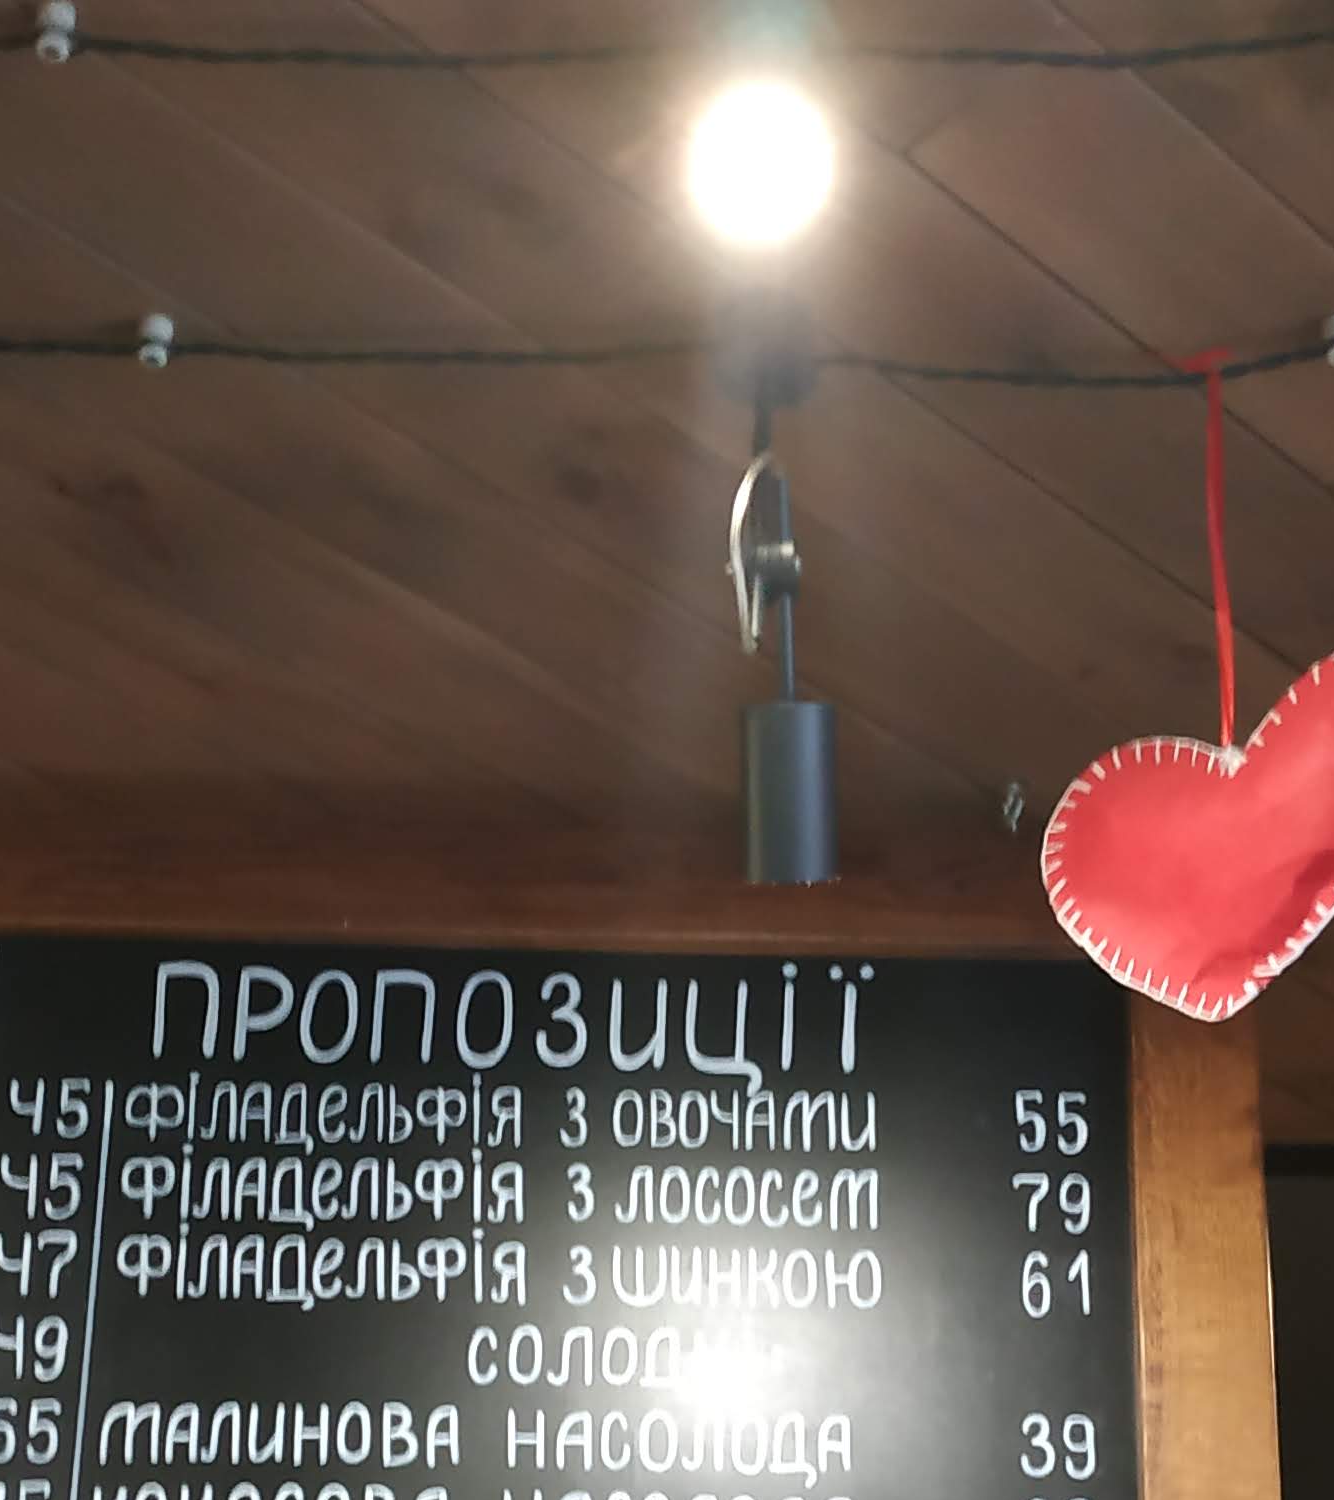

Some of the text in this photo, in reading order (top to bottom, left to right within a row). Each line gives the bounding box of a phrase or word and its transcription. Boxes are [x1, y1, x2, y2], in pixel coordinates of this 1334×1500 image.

[152, 959, 875, 1098] ПРОПОЗИЦІЇ
[9, 1077, 92, 1140] 45
[124, 1070, 523, 1156] ФІЛАДЕЛЬФІЯ
[611, 1088, 878, 1153] ОВОЧАМИ
[1013, 1088, 1090, 1156] 55
[0, 1152, 83, 1223] 45
[120, 1142, 525, 1232] ФІЛАДЕЛЬФІЯ
[613, 1164, 880, 1232] ЛОСОСЕМ
[1011, 1171, 1093, 1235] 79
[116, 1221, 527, 1312] ФІЛАДЕЛЬФІЯ
[611, 1245, 883, 1310] ШИНКОЮ
[1021, 1249, 1093, 1319] 61
[98, 1400, 1097, 1489] МАЛИНОВА НАСОЛОДА 39
